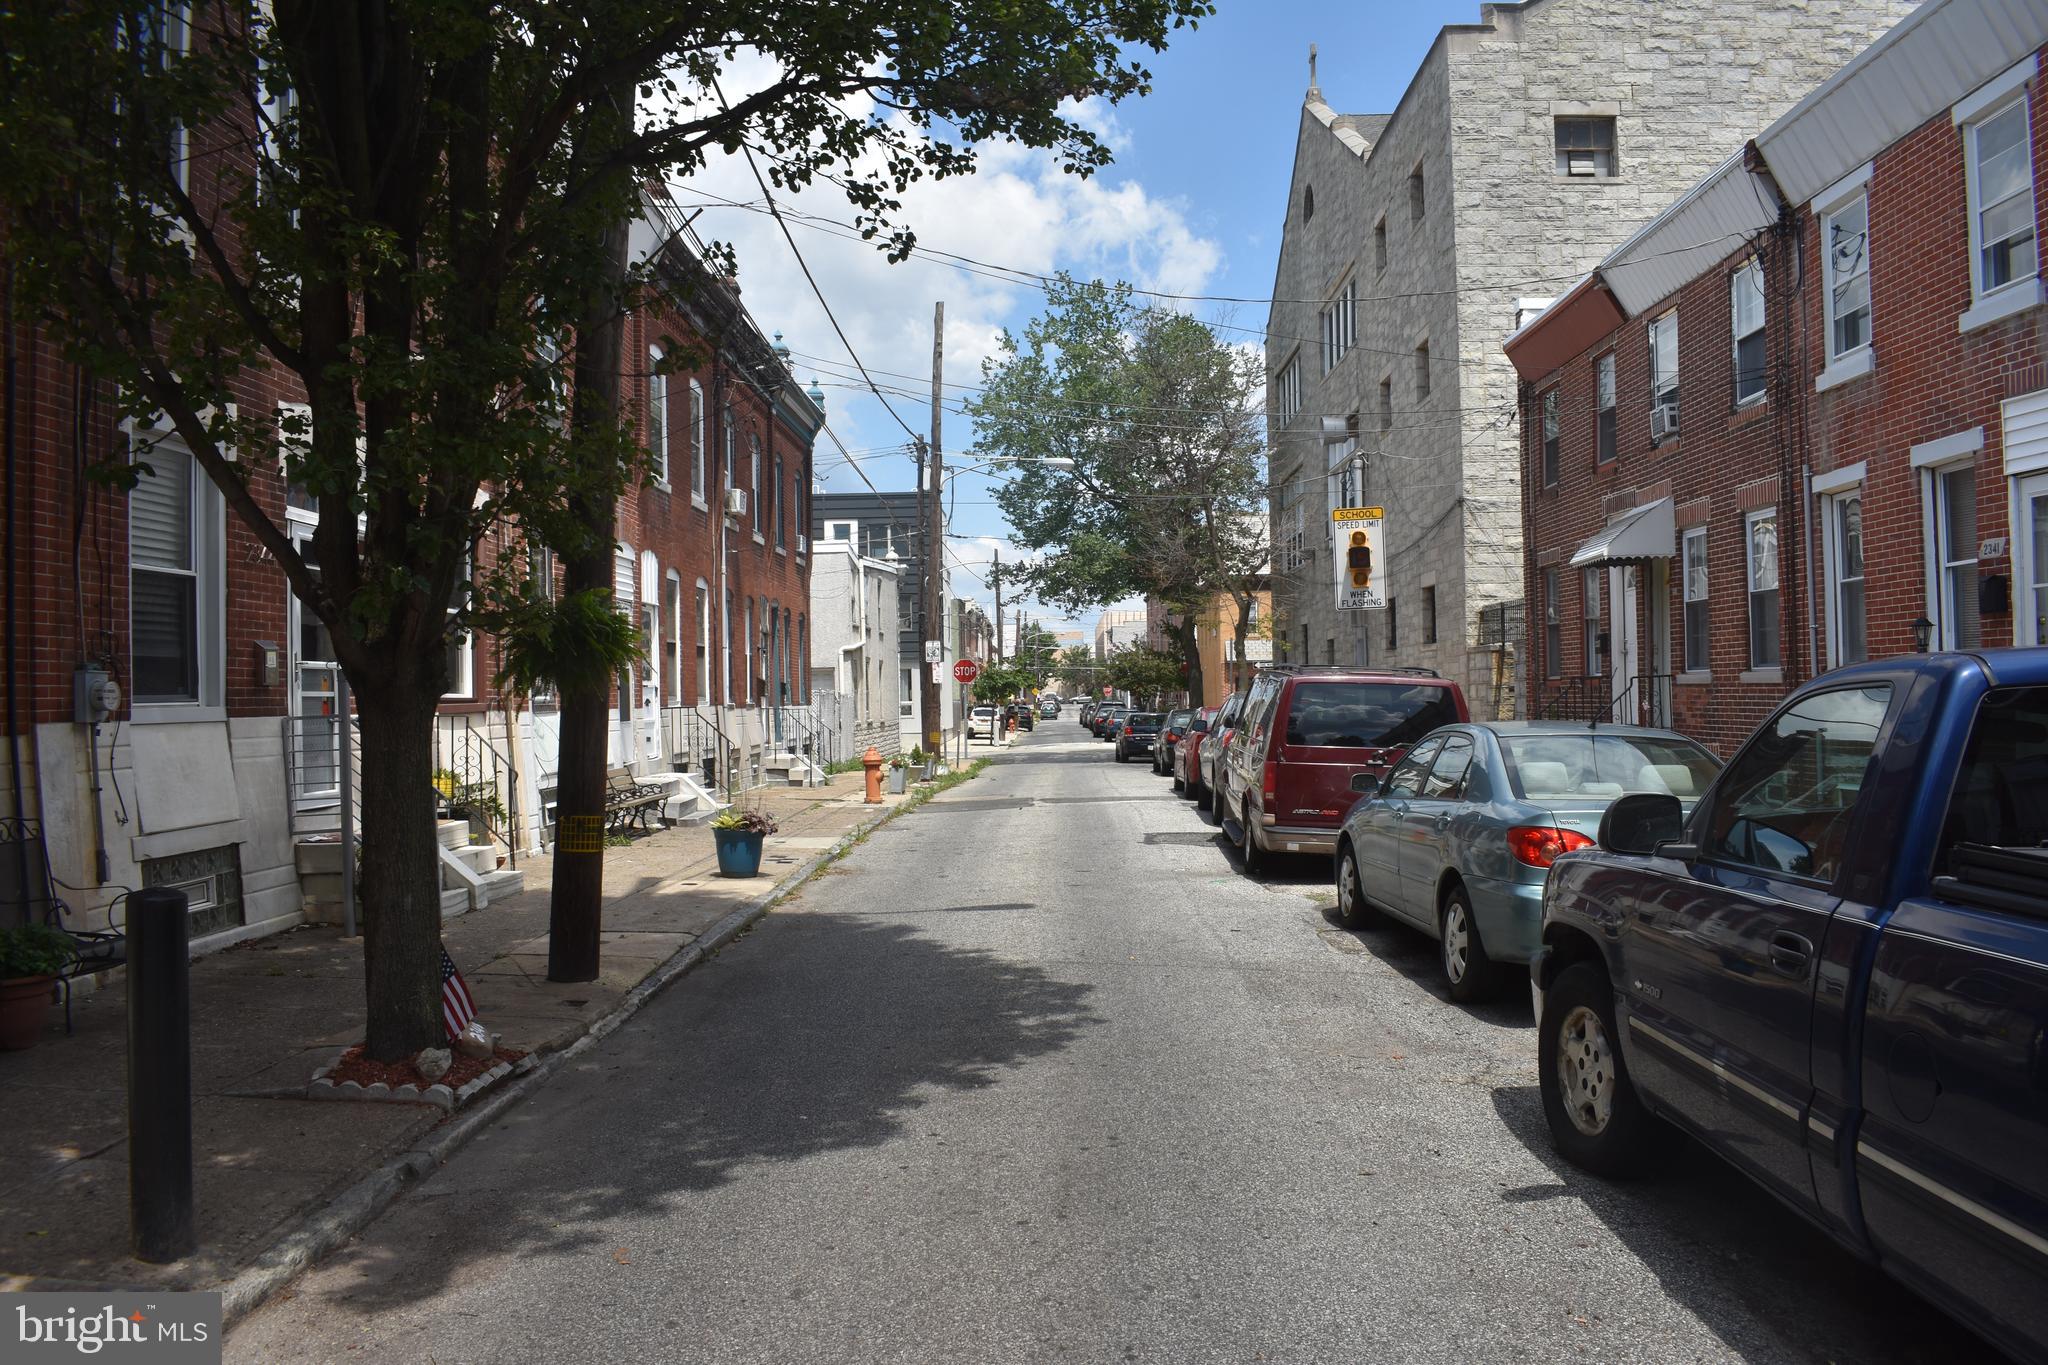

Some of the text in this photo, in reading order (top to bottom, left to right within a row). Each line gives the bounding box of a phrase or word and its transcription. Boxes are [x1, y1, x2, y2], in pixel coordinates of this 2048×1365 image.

[1340, 511, 1377, 519] SCHOOL
[1337, 520, 1380, 529] SPEED LIMIT
[1983, 543, 2000, 555] 2341
[1350, 590, 1373, 599] WHEN
[1342, 599, 1382, 608] FLASHING
[954, 666, 976, 676] STOP
